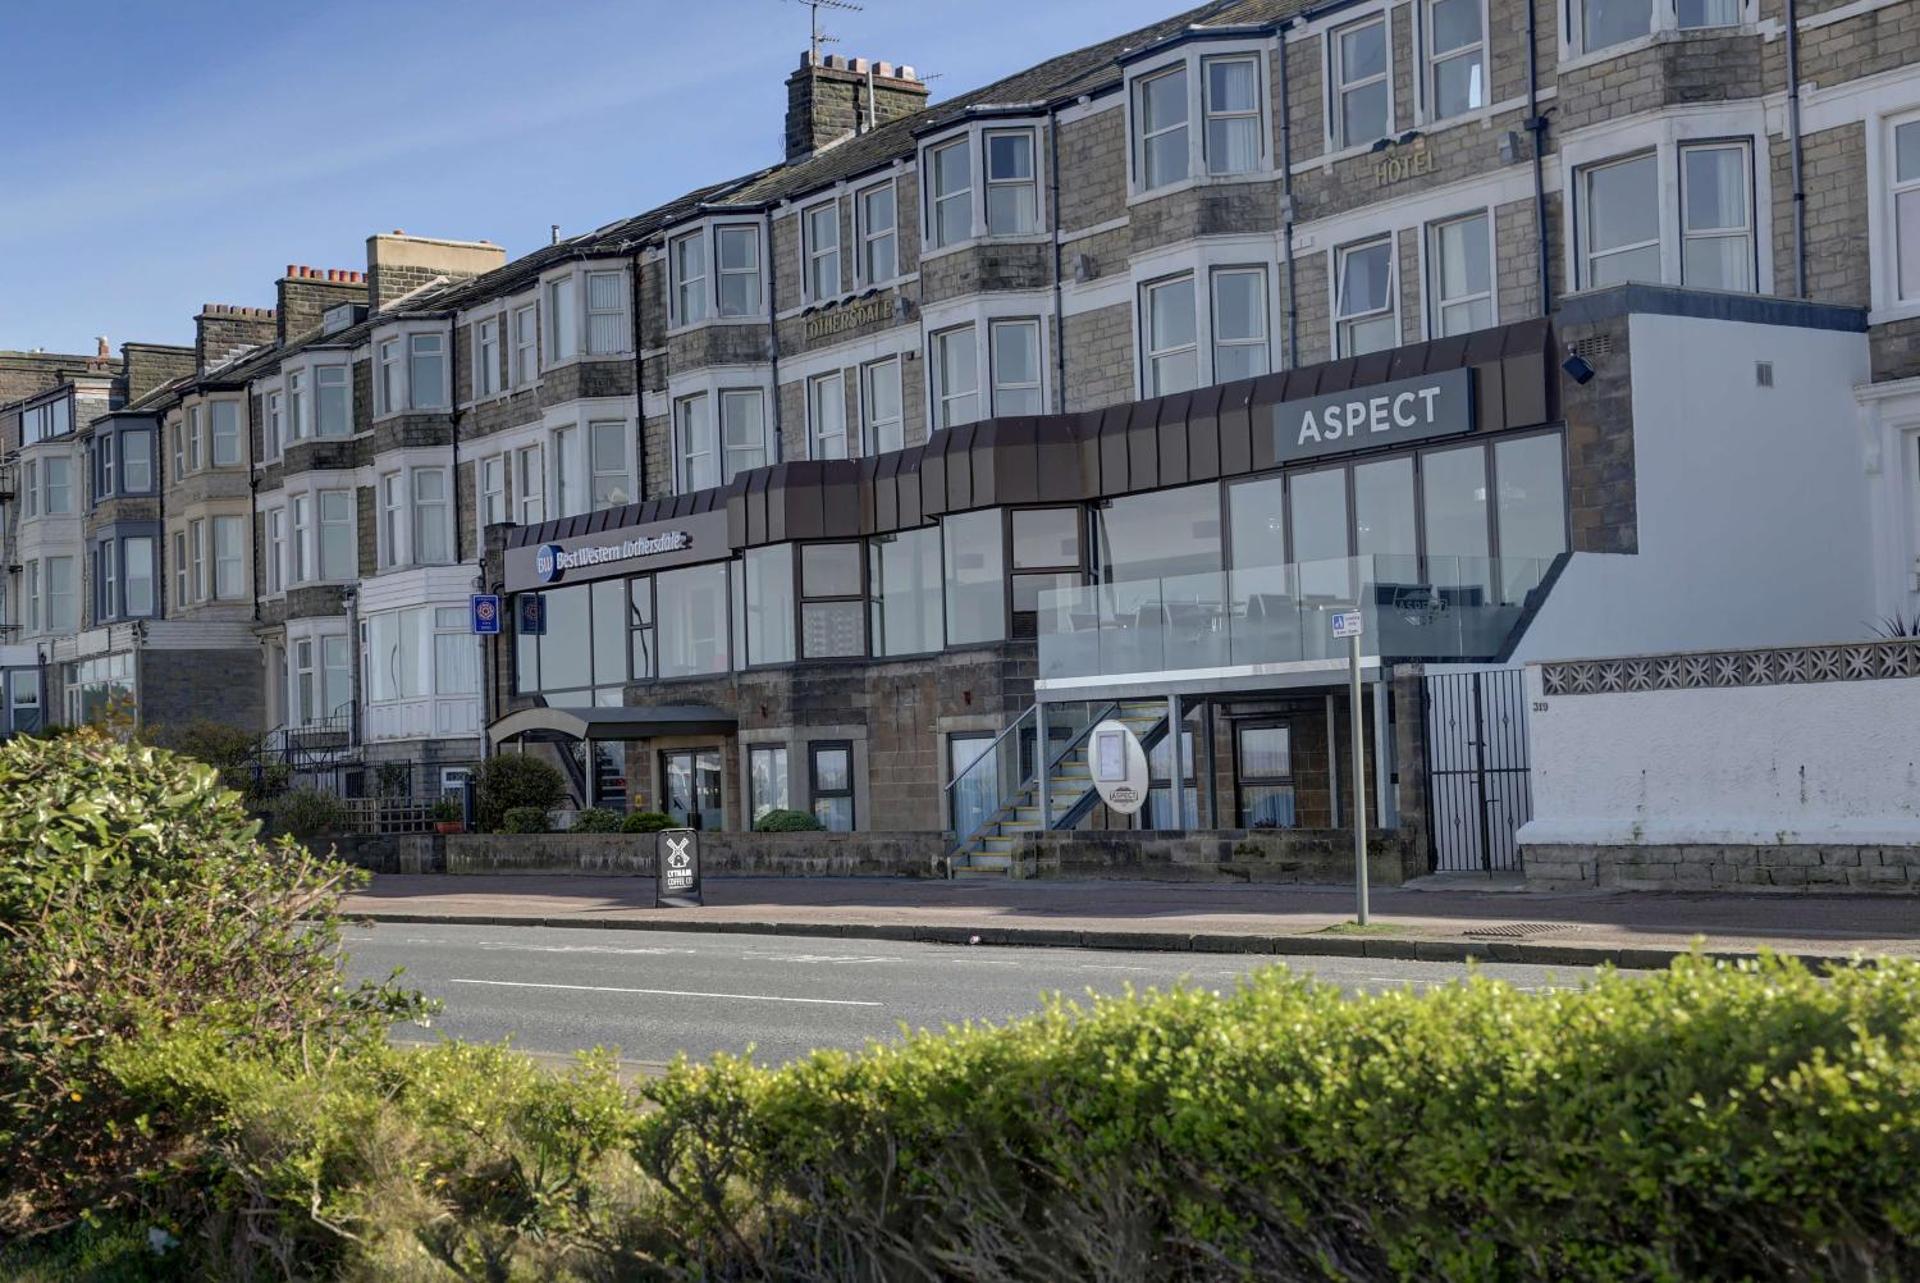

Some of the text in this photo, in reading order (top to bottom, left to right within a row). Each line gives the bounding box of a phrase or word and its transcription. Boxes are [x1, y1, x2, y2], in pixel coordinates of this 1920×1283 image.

[1376, 150, 1441, 185] HOTEL
[1297, 386, 1441, 445] ASPECT
[556, 552, 578, 570] Best
[579, 546, 620, 565] Western
